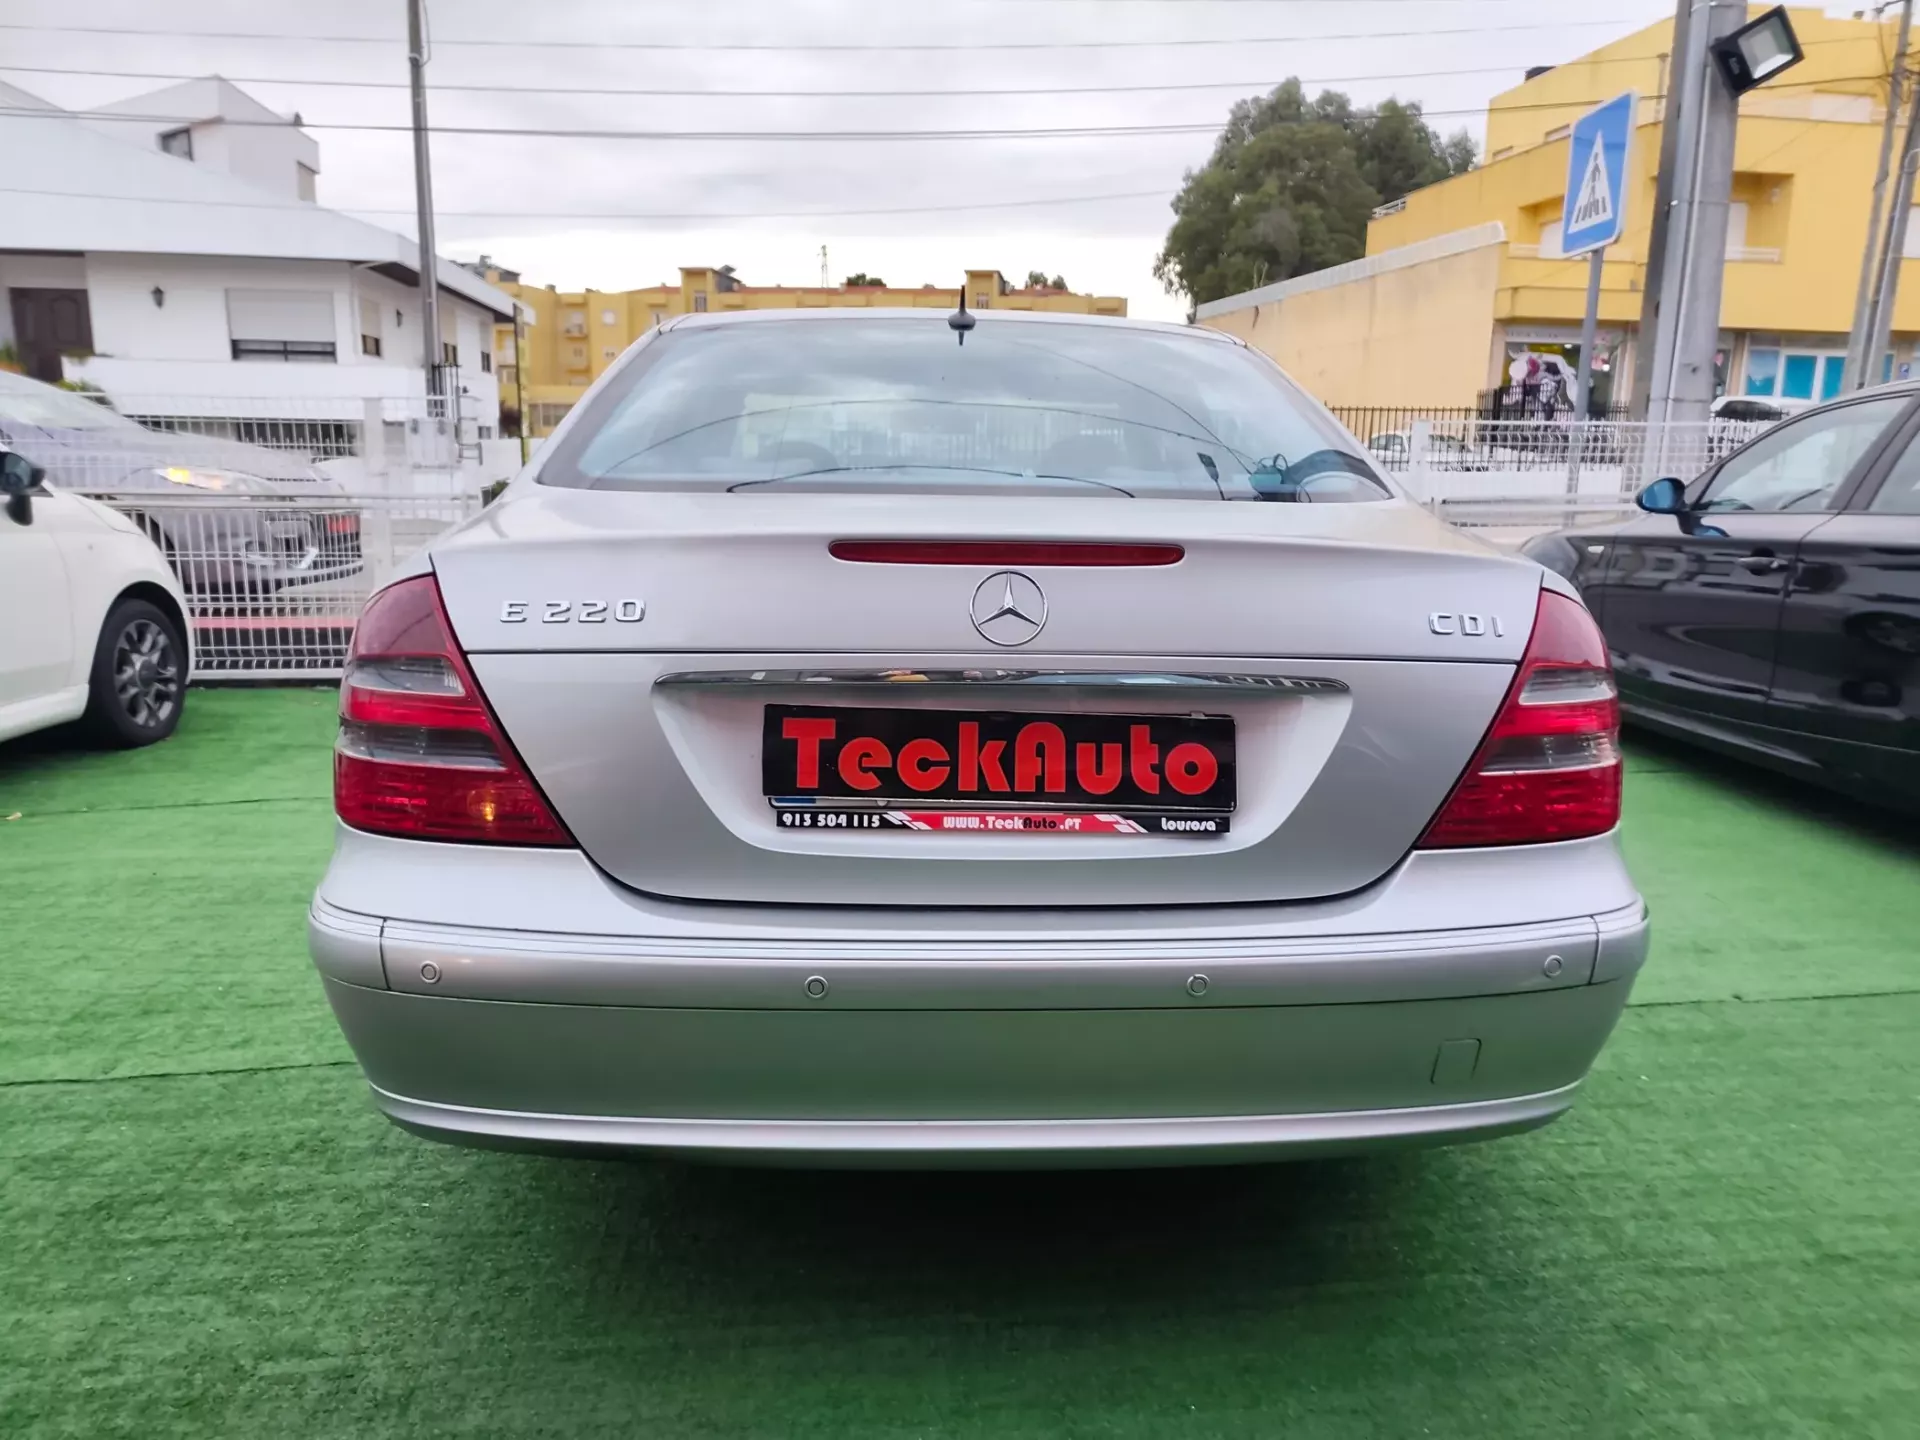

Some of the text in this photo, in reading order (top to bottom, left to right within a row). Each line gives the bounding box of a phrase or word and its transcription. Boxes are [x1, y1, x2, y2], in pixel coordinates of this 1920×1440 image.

[500, 598, 647, 624] E 220
[1428, 611, 1505, 638] CDI
[782, 717, 1219, 796] TeckAuto
[782, 812, 881, 828] 913 504 115
[1161, 817, 1217, 831] Lourosa
